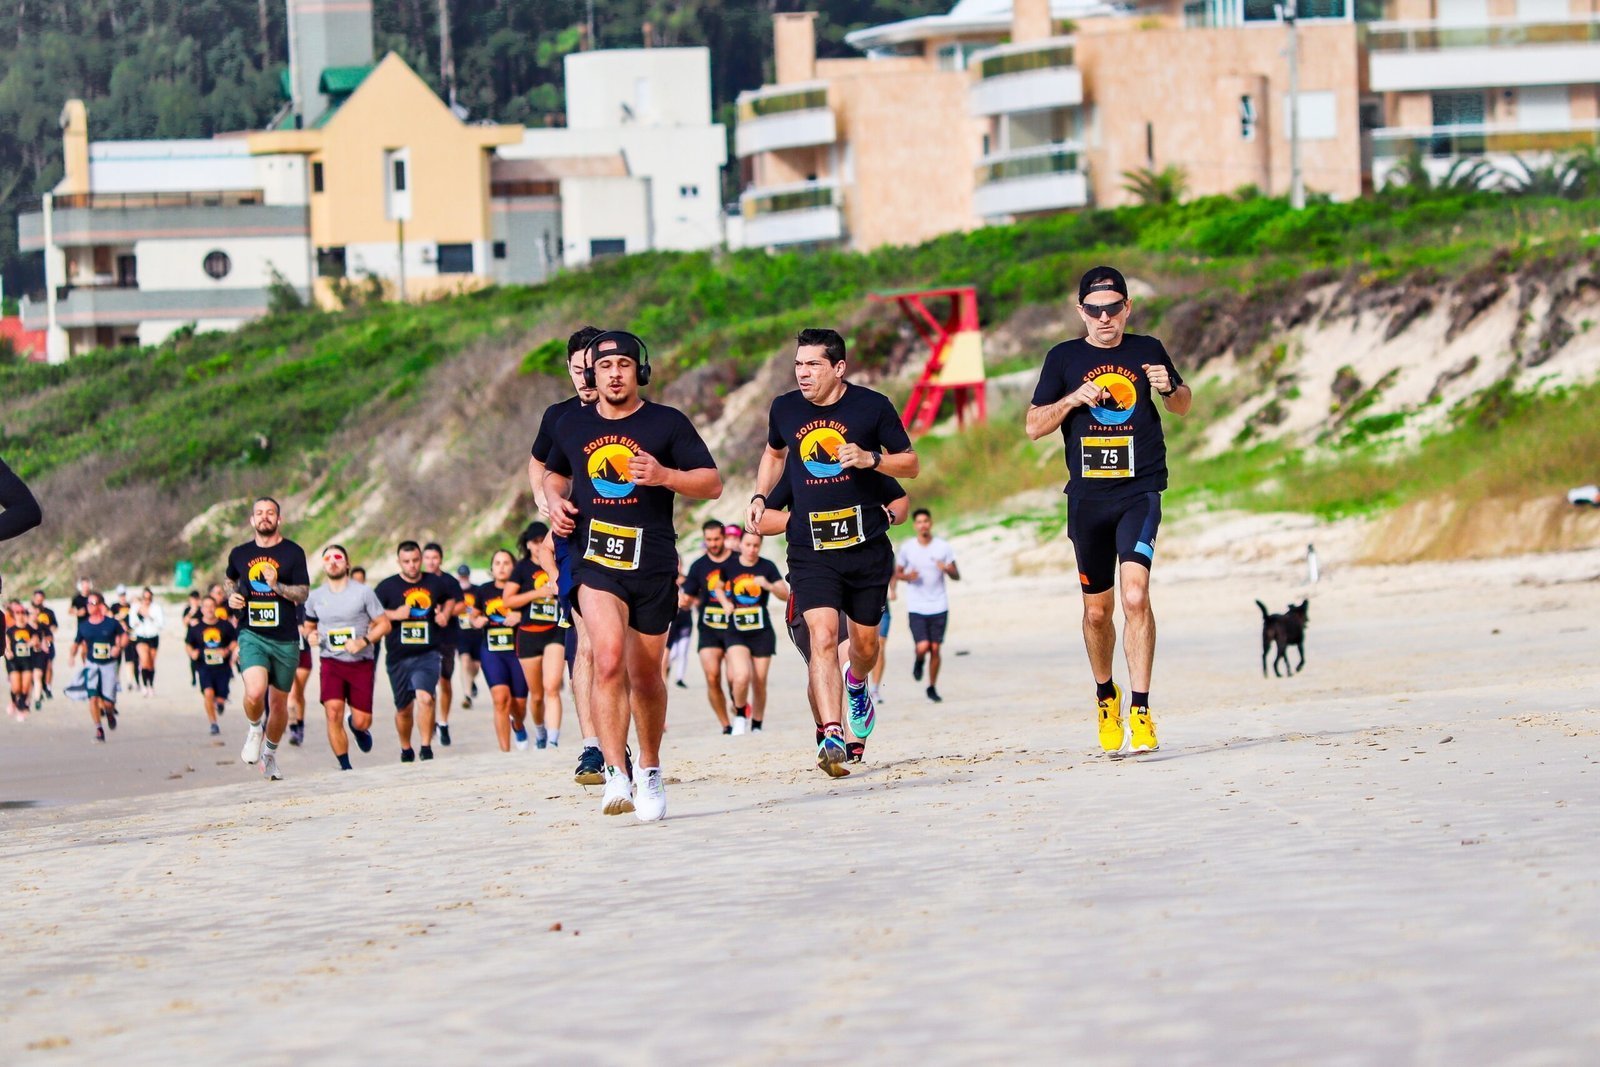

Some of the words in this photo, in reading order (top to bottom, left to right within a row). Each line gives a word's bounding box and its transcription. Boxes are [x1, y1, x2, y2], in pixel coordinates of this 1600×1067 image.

[1083, 365, 1114, 382] SOUTH
[1117, 366, 1138, 383] RUN
[795, 420, 826, 440] SOUTH
[828, 420, 848, 435] RUN
[583, 435, 617, 455] SOUTH
[619, 436, 640, 453] RUN
[1101, 449, 1119, 465] 75
[831, 520, 849, 536] 74
[606, 537, 625, 555] 95
[259, 609, 274, 619] 100
